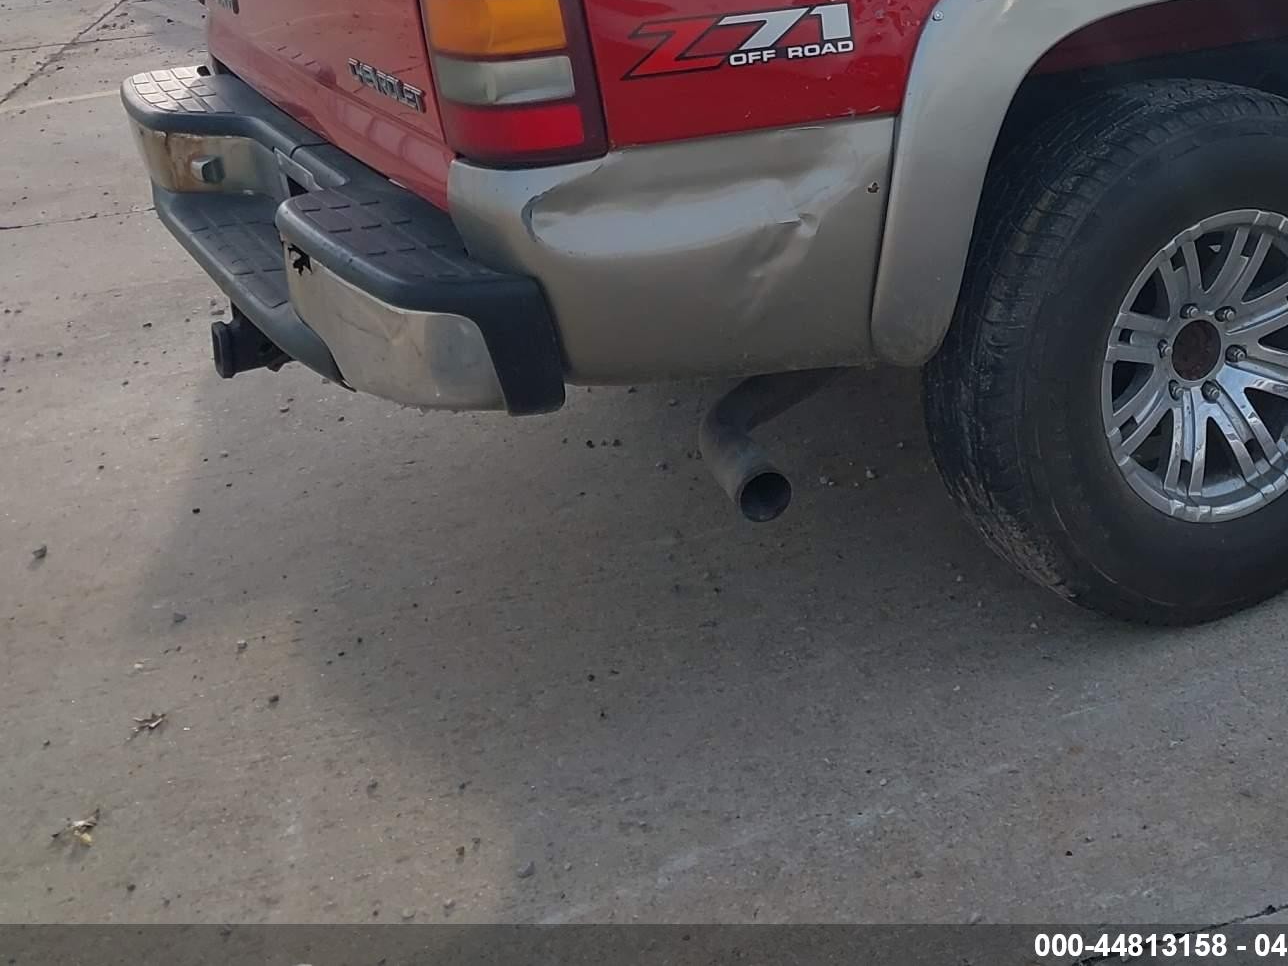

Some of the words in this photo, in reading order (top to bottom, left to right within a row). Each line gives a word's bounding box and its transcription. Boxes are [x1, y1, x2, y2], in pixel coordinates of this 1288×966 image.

[620, 1, 853, 80] Z71
[728, 49, 777, 67] OFF
[787, 39, 855, 59] ROAD
[347, 47, 425, 114] CHEVROLET
